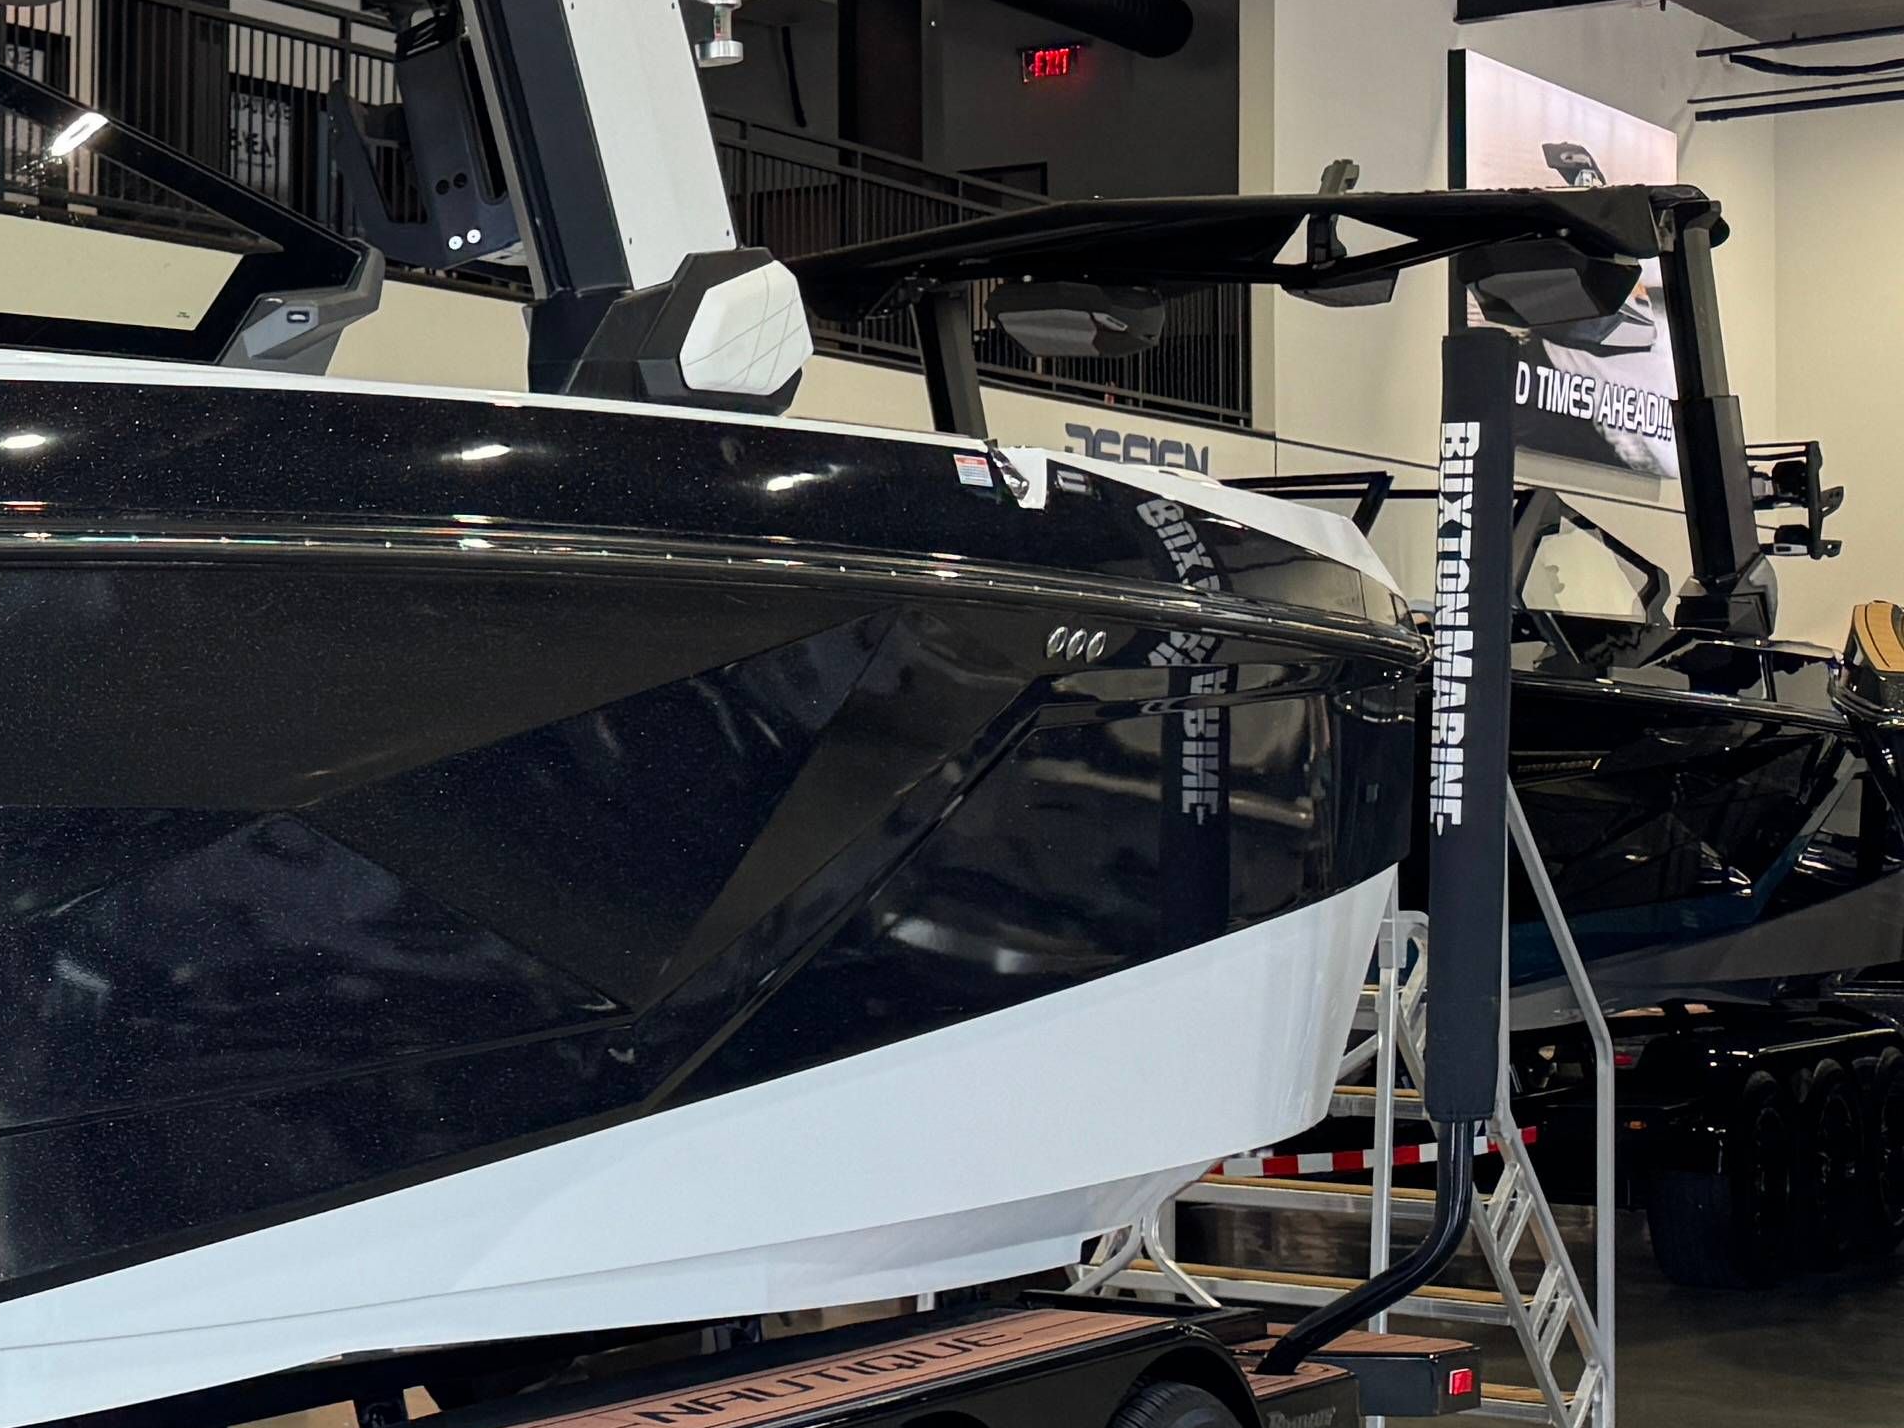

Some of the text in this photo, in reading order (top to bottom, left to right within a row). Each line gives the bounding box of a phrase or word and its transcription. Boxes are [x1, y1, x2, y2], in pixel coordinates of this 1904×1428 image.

[1536, 365, 1596, 420] TIMES
[1598, 382, 1673, 441] AHEAD!!!
[633, 1332, 1022, 1424] NAUTIQUE
